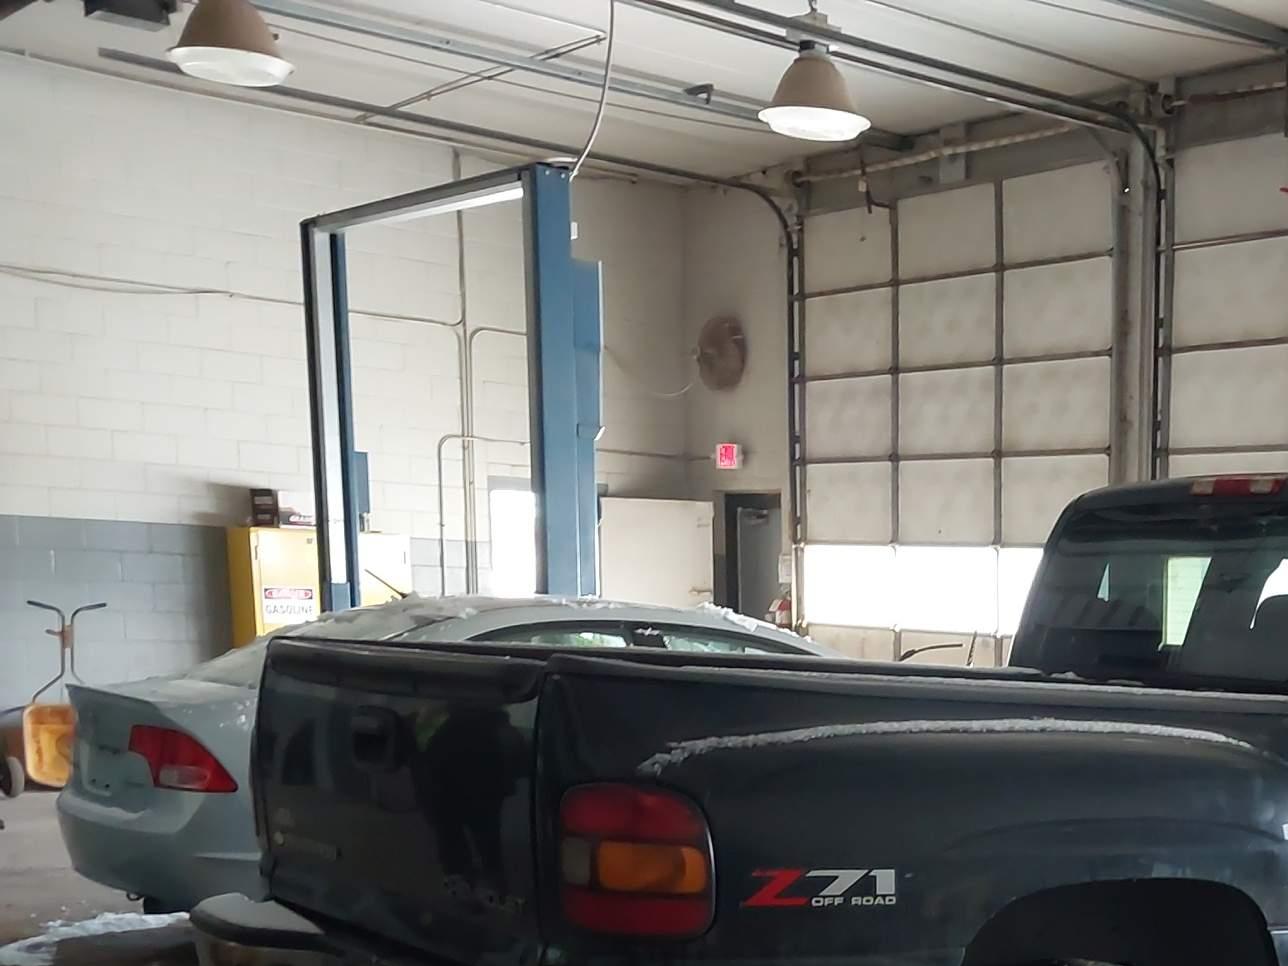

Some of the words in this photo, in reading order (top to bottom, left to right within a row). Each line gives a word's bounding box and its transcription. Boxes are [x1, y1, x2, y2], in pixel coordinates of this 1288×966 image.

[265, 604, 313, 615] GASOLINE
[741, 868, 896, 907] Z71
[811, 897, 844, 907] OFF
[851, 896, 897, 906] ROAD
